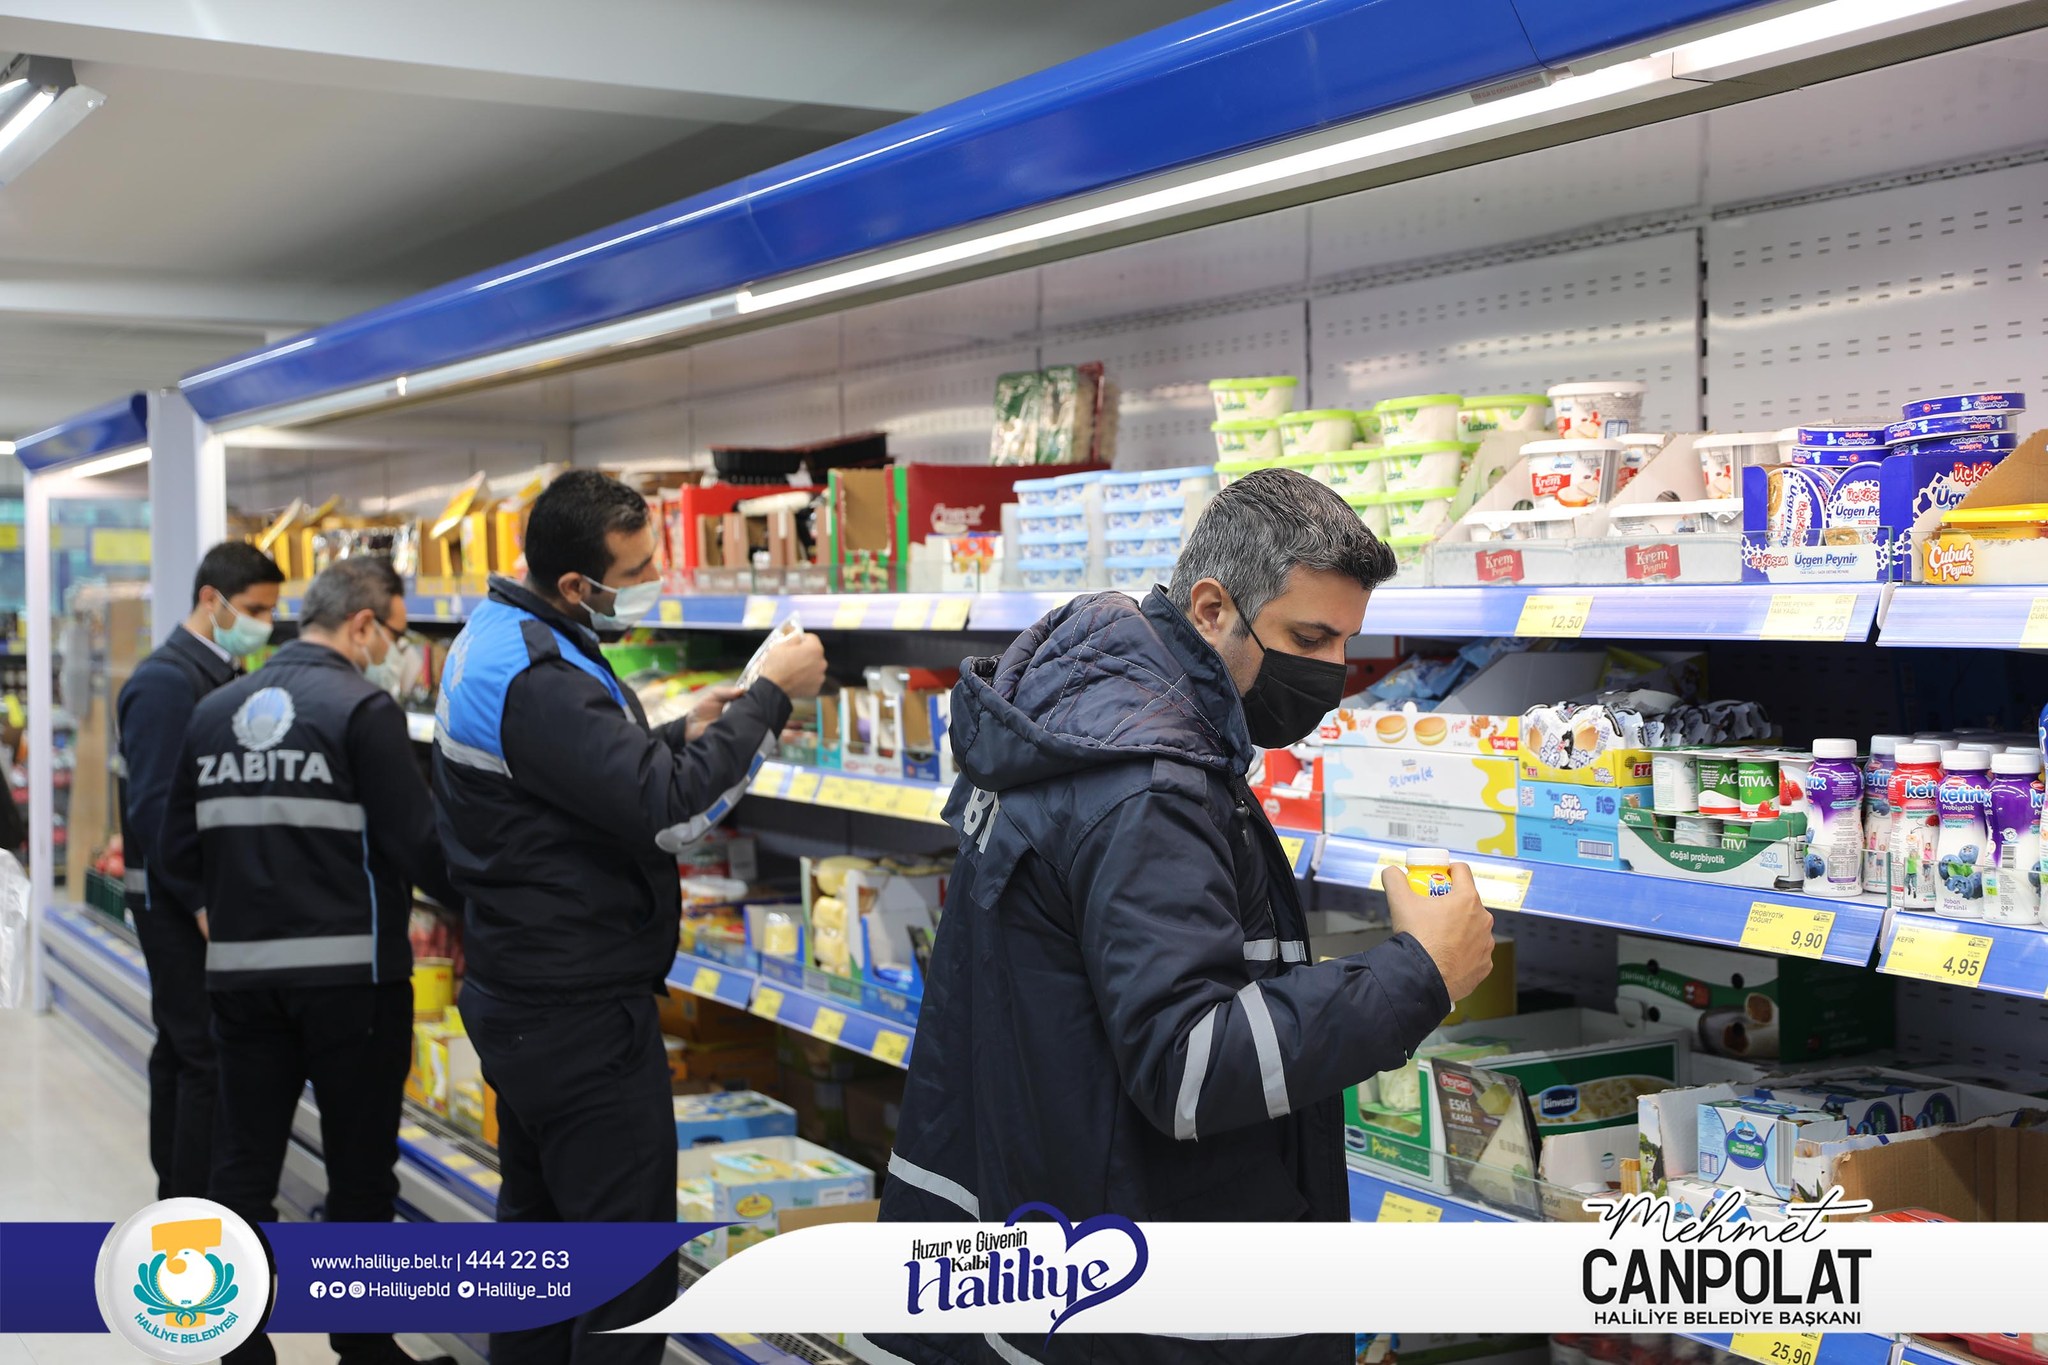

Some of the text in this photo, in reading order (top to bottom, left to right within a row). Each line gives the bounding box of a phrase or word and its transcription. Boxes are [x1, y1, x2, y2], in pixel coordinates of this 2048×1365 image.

[1836, 503, 1865, 519] Üçgen
[1485, 552, 1514, 569] Krem
[1635, 549, 1669, 566] Krem
[1794, 552, 1857, 568] Üçgen Peynir
[1929, 544, 1974, 575] Çubuk
[1551, 615, 1582, 630] 12,50
[1813, 615, 1847, 632] 5,25
[197, 749, 333, 786] ZABITA
[1561, 793, 1580, 810] Süt
[1553, 804, 1588, 825] Burger
[1670, 850, 1725, 864] doğal probiyotik
[1791, 930, 1823, 949] 9,90
[1896, 936, 1915, 944] KEFİR
[1943, 956, 1980, 976] 4,95
[1448, 1098, 1472, 1113] ESKİ
[1770, 1341, 1812, 1365] 25,90
